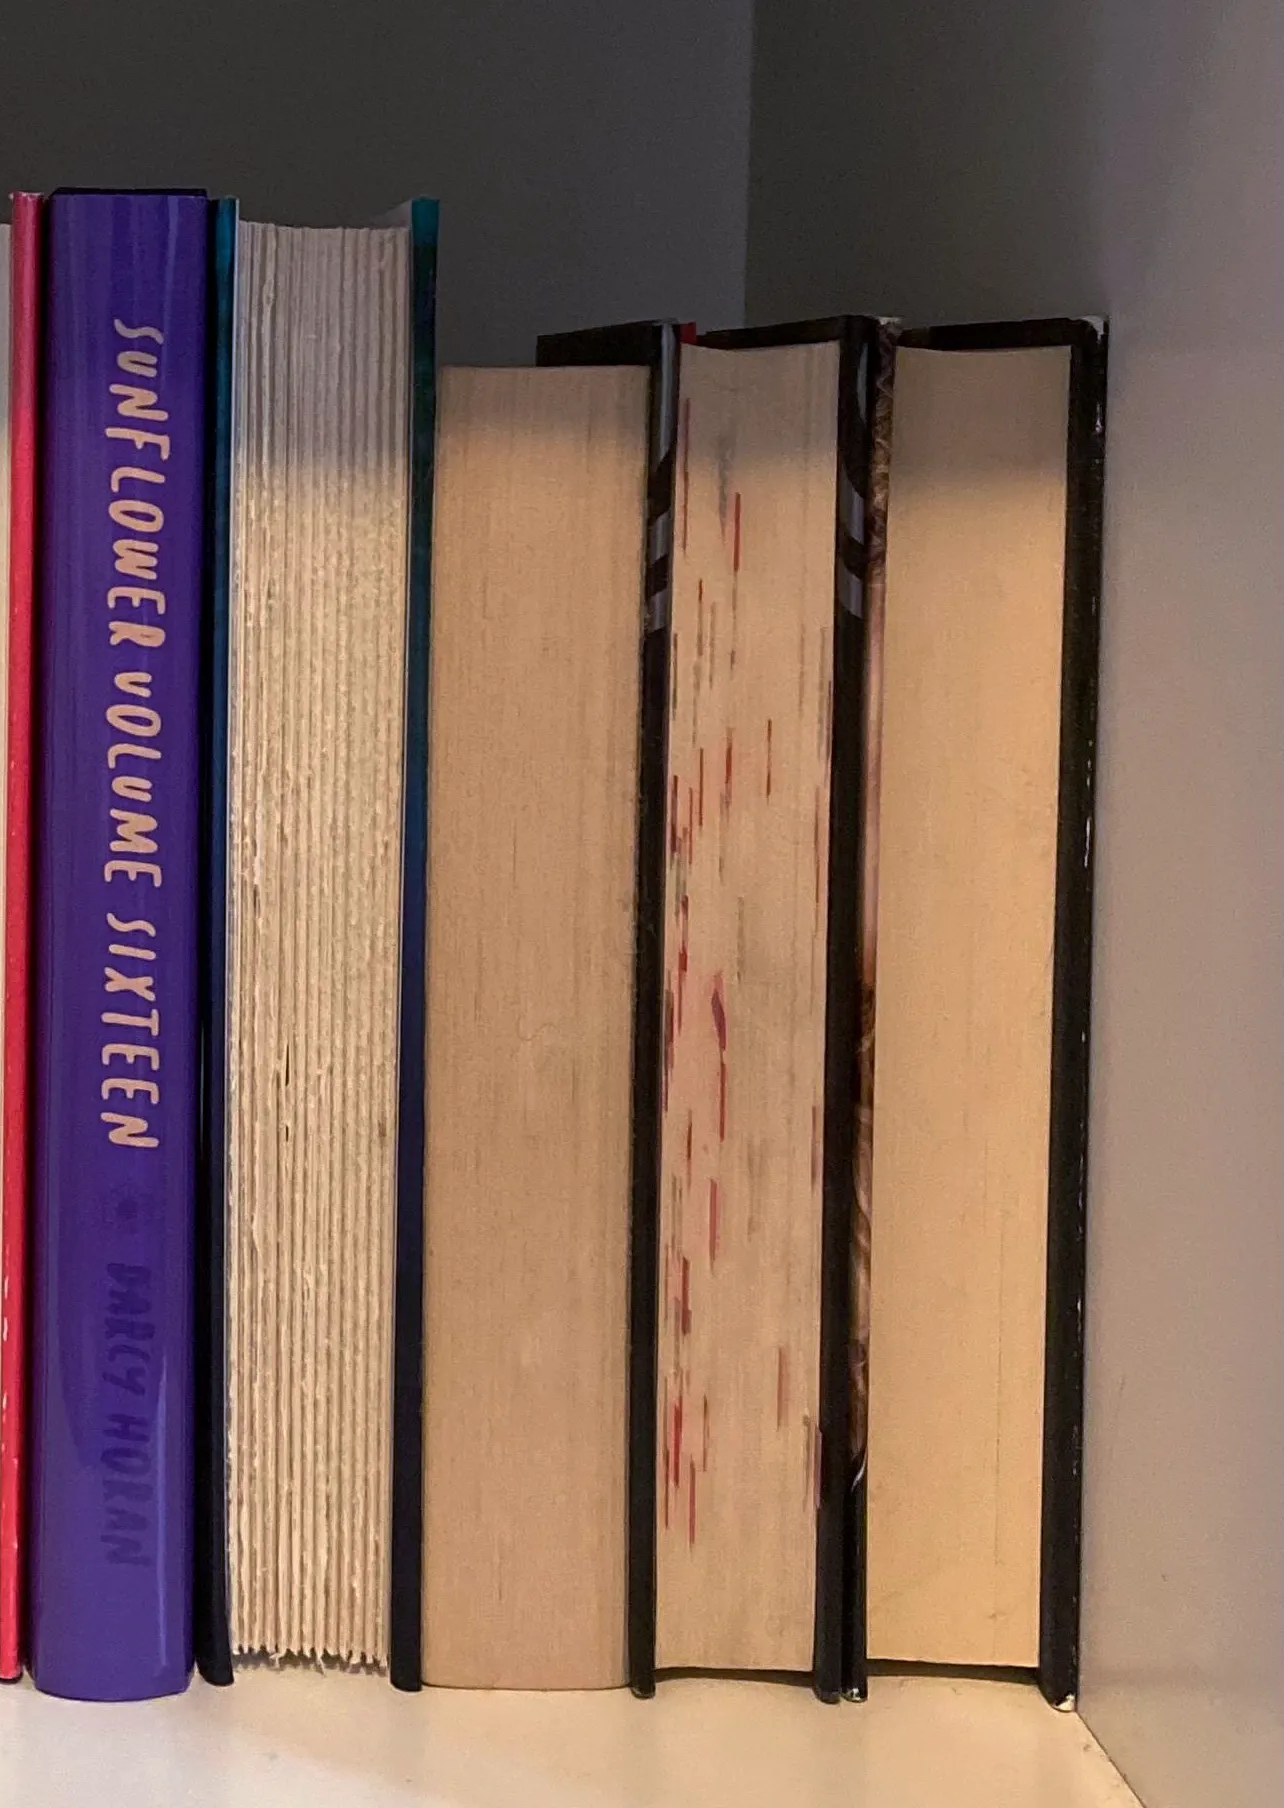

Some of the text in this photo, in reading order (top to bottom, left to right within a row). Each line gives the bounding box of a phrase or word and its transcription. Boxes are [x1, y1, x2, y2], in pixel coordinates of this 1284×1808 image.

[100, 318, 171, 1149] SUNFLOWER VOLUME SIXTEEN
[100, 1262, 155, 1567] DARCY HORAN
